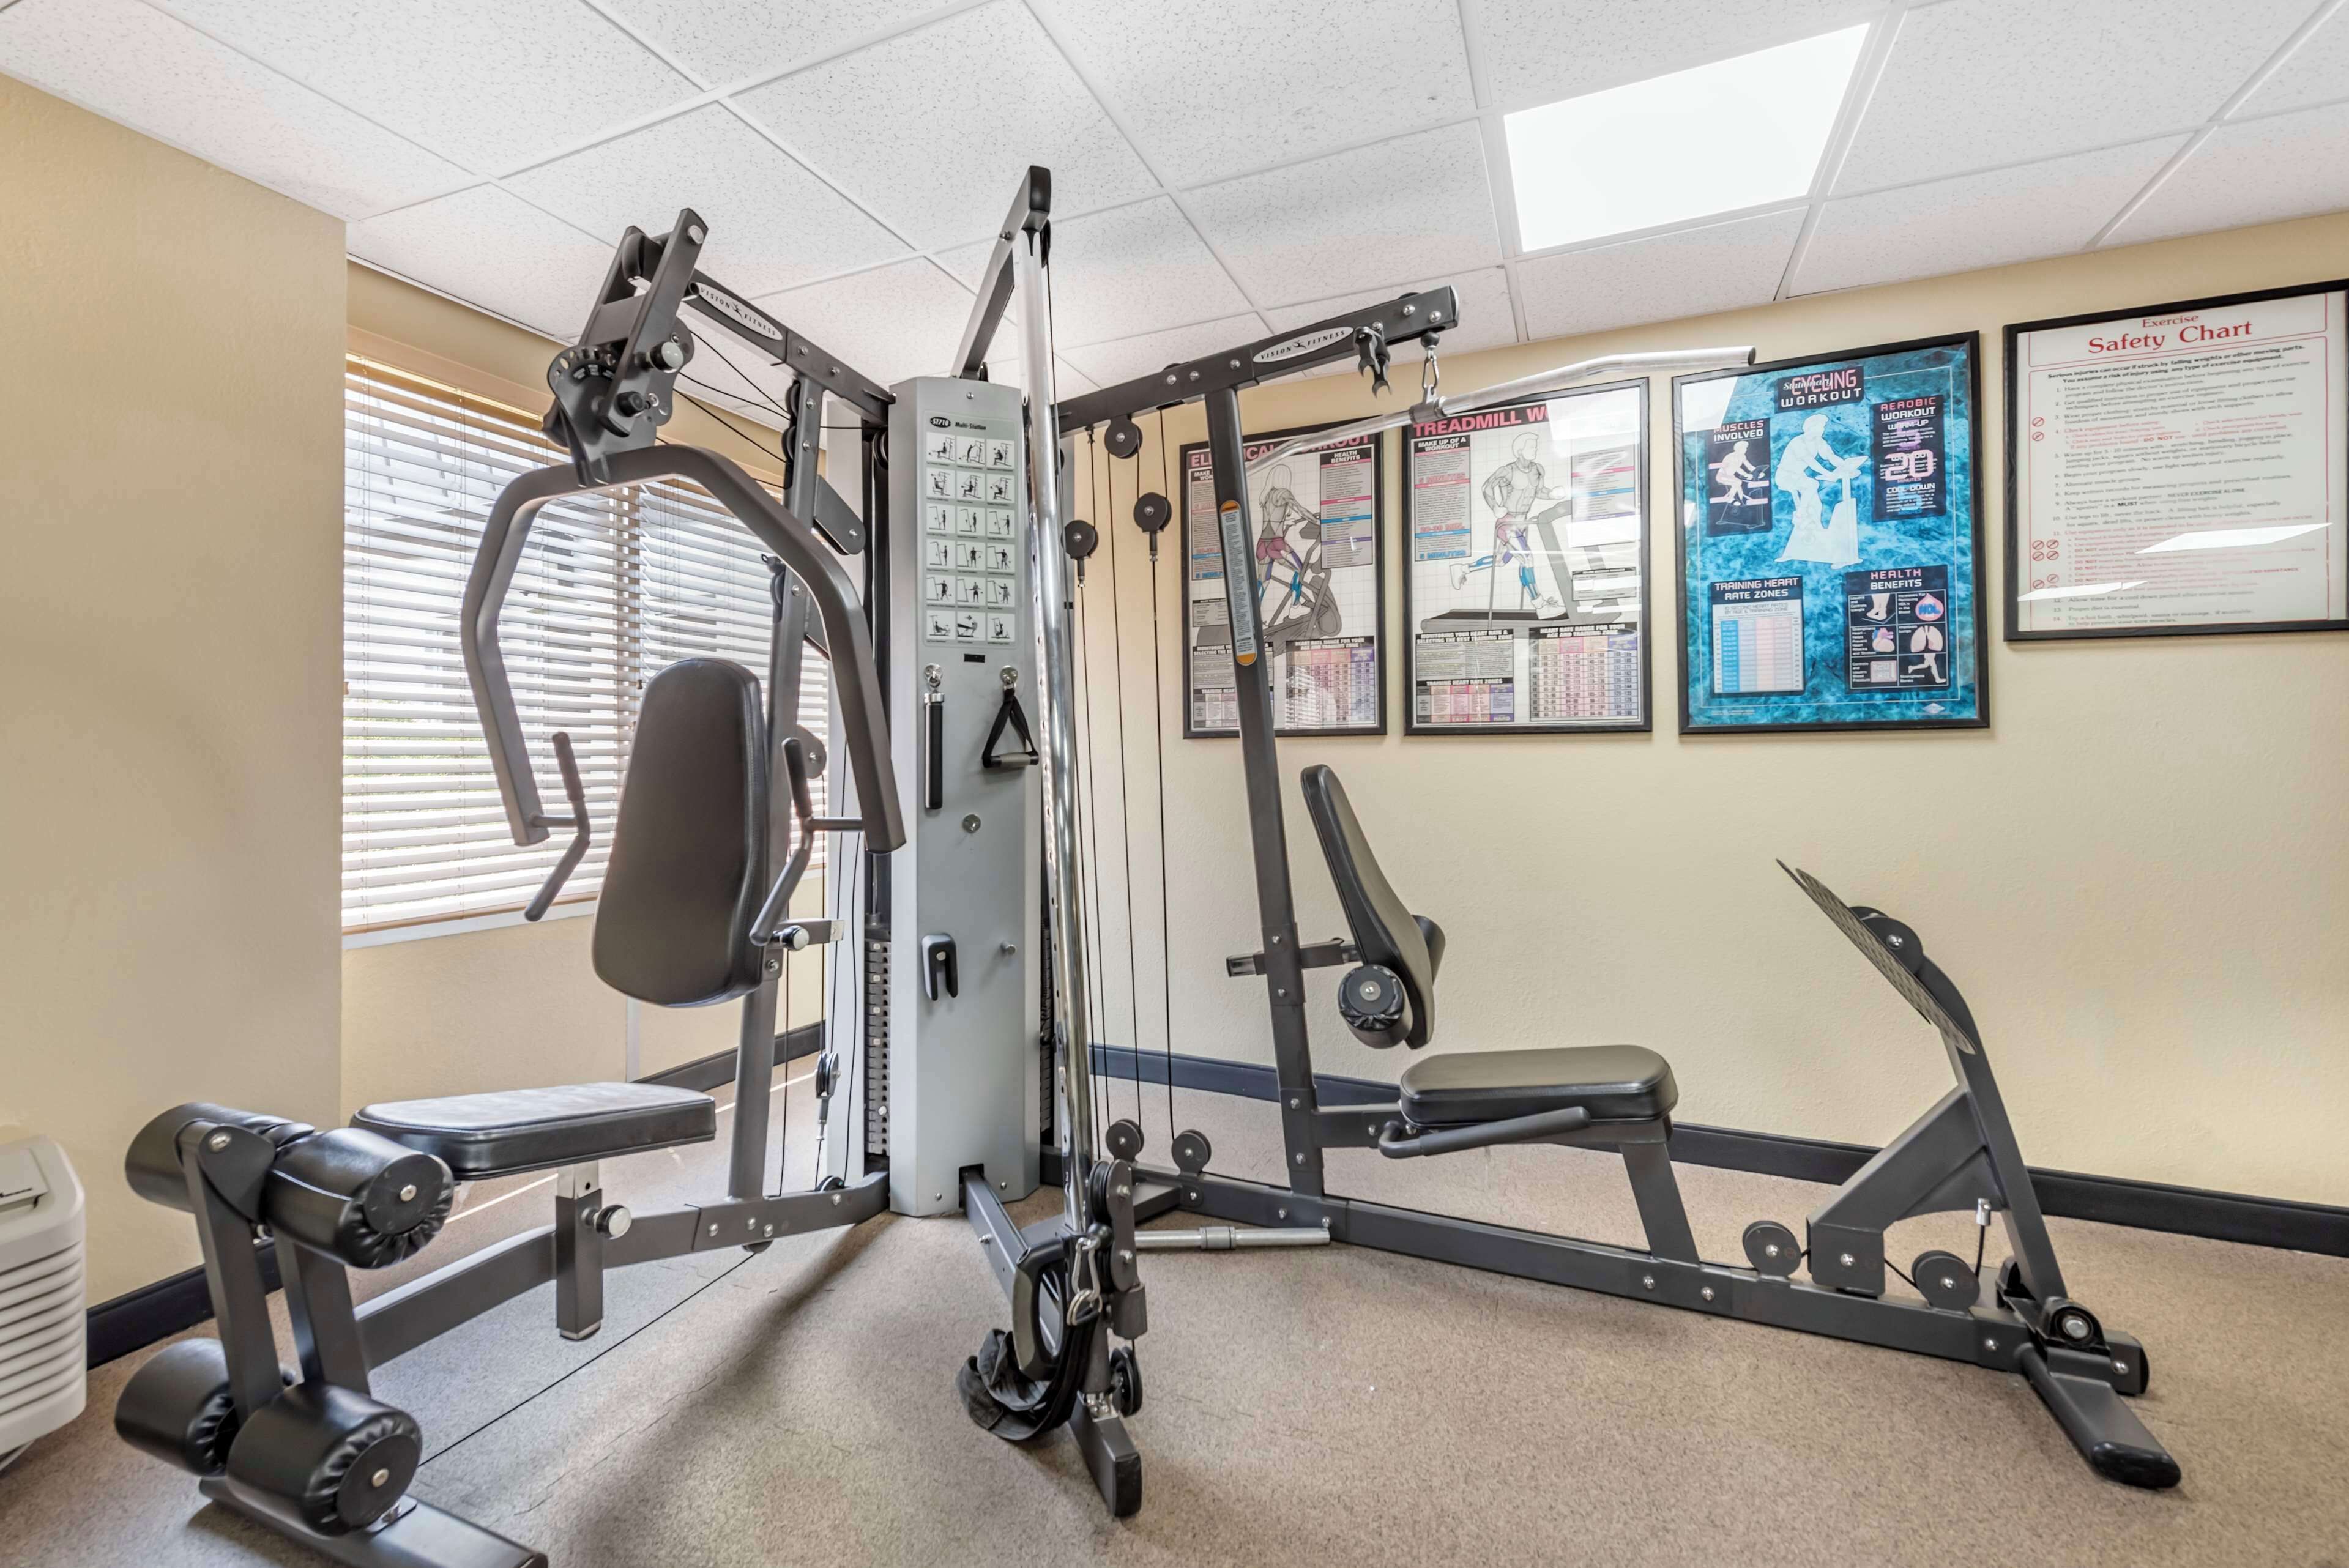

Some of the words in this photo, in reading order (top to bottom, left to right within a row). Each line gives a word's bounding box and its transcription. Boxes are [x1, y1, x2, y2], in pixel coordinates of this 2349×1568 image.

[701, 288, 729, 308] VISION
[745, 314, 775, 336] FITNESS
[2142, 314, 2198, 328] Exercise
[2088, 333, 2165, 354] Safety
[2179, 321, 2252, 343] Chart
[1261, 347, 1291, 359] VISION
[1308, 330, 1345, 346] FITNESS
[1783, 378, 1831, 391] Stationary
[1792, 370, 1856, 395] CYCLING
[1781, 388, 1861, 407] WORKOUT
[1881, 398, 1936, 411] AEROBIC
[1881, 407, 1935, 421] WORKOUT
[932, 418, 948, 426] ST710
[1413, 411, 1522, 437] TREADMILL
[1714, 420, 1763, 433] MUSCLES
[1888, 420, 1929, 430] WARM-UP
[1714, 429, 1763, 442] INVOLVED
[1425, 443, 1459, 451] WORKOUT
[1885, 449, 1934, 481] 20
[1886, 482, 1935, 494] COOL-DOWN
[1871, 569, 1921, 579] HEALTH
[1715, 581, 1761, 590] TRAINING
[1764, 578, 1798, 587] HEART
[1871, 579, 1922, 590] BENEFITS
[1725, 592, 1751, 600] RATE
[1754, 589, 1789, 598] ZONES
